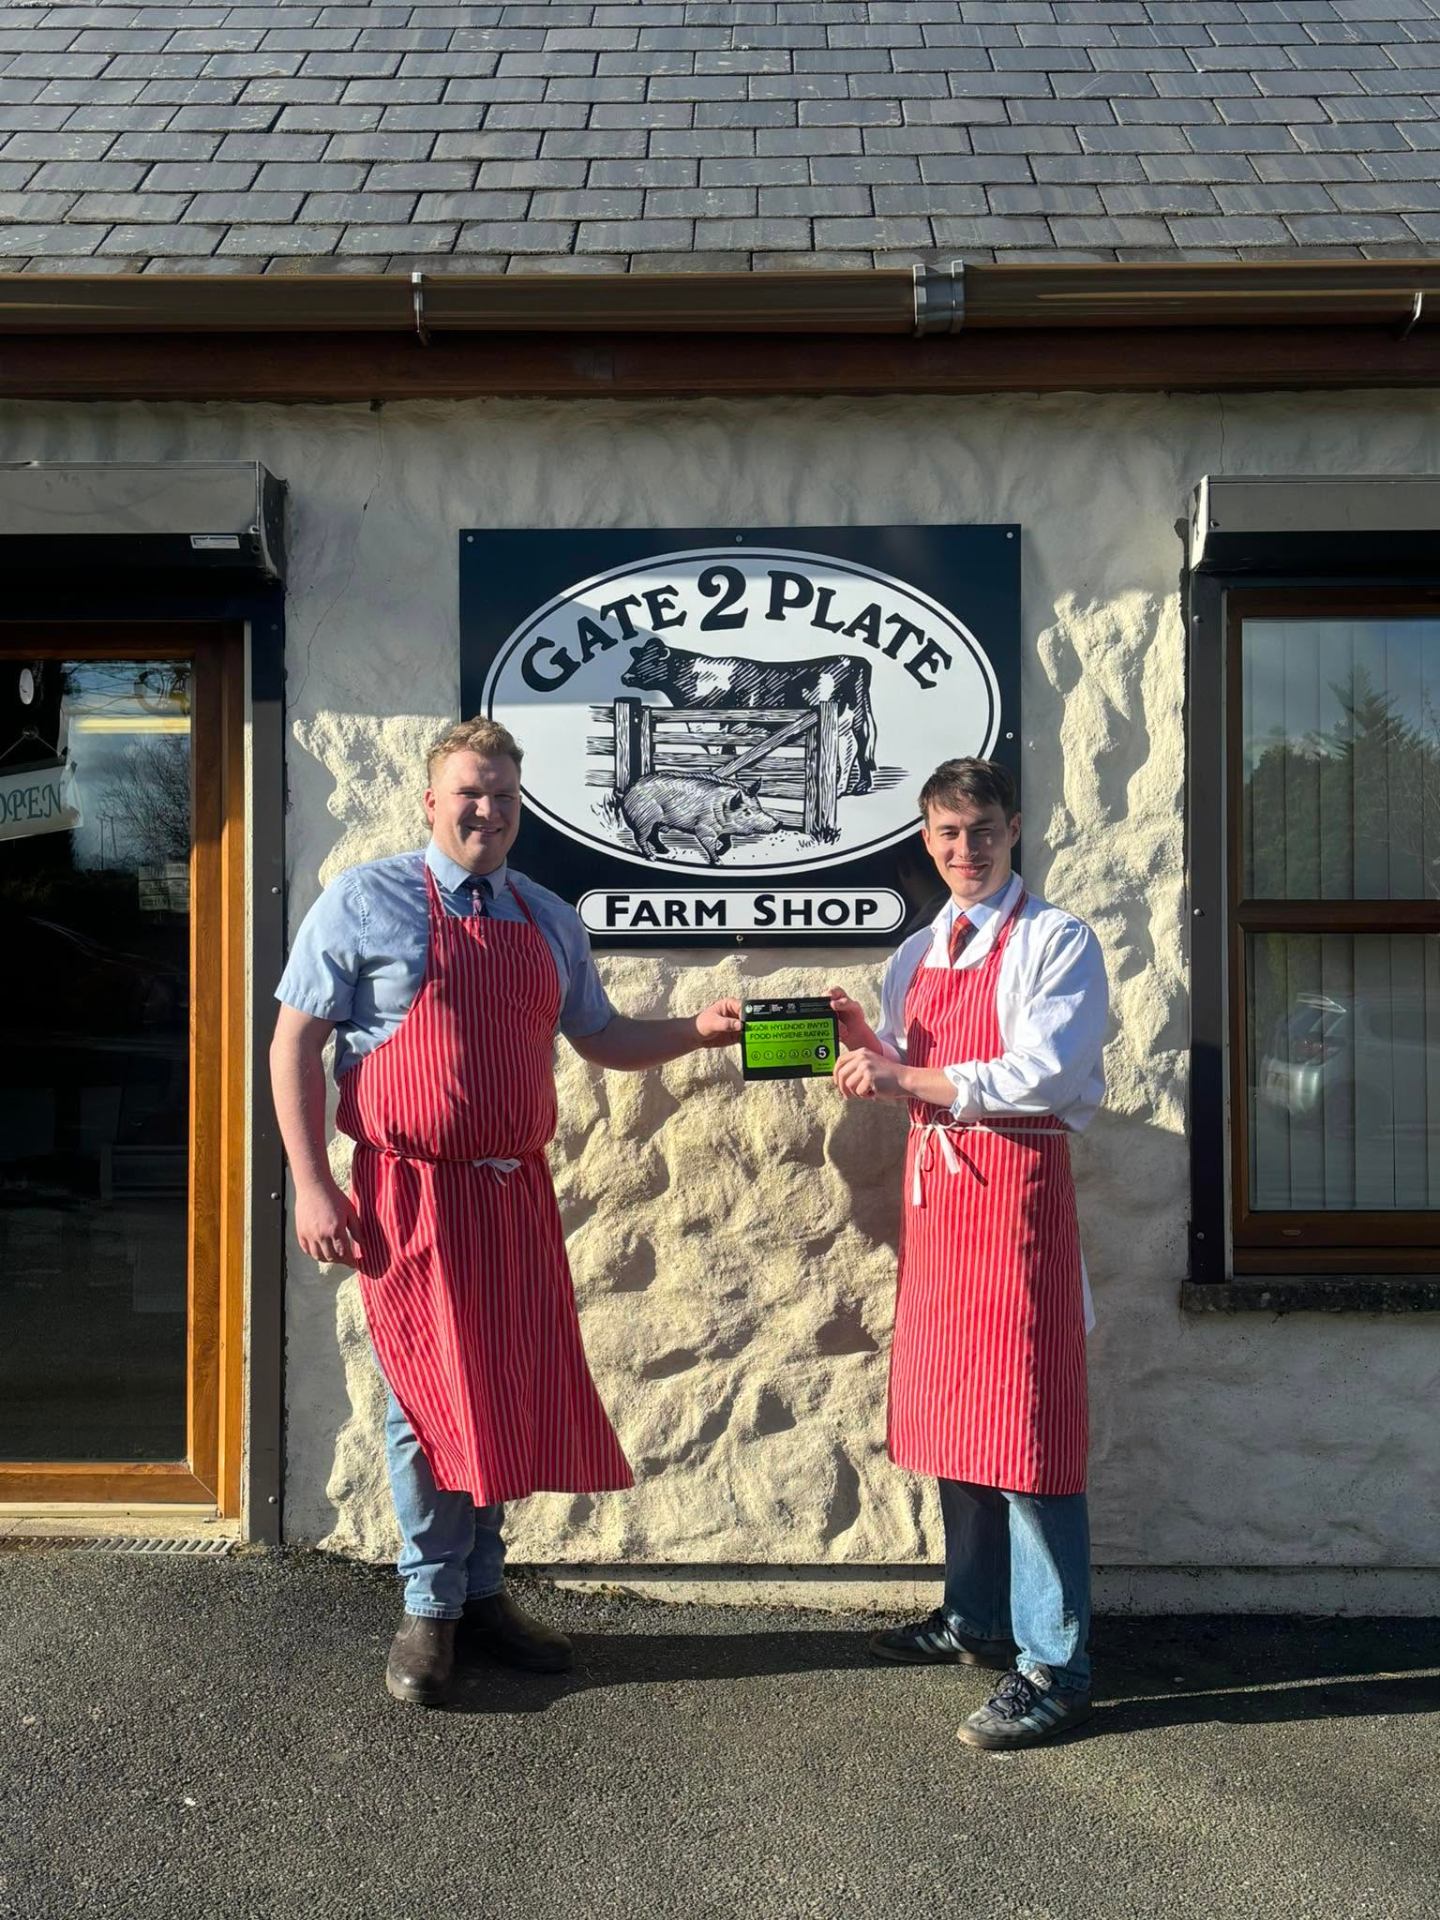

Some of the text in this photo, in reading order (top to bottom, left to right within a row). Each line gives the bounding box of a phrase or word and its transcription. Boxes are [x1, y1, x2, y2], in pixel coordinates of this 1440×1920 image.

[521, 566, 952, 693] GATE 2 PLATE
[606, 894, 879, 927] FARM SHOP
[750, 1032, 771, 1040] FOOD
[772, 1031, 803, 1039] HYGIENE
[818, 1046, 827, 1059] 5
